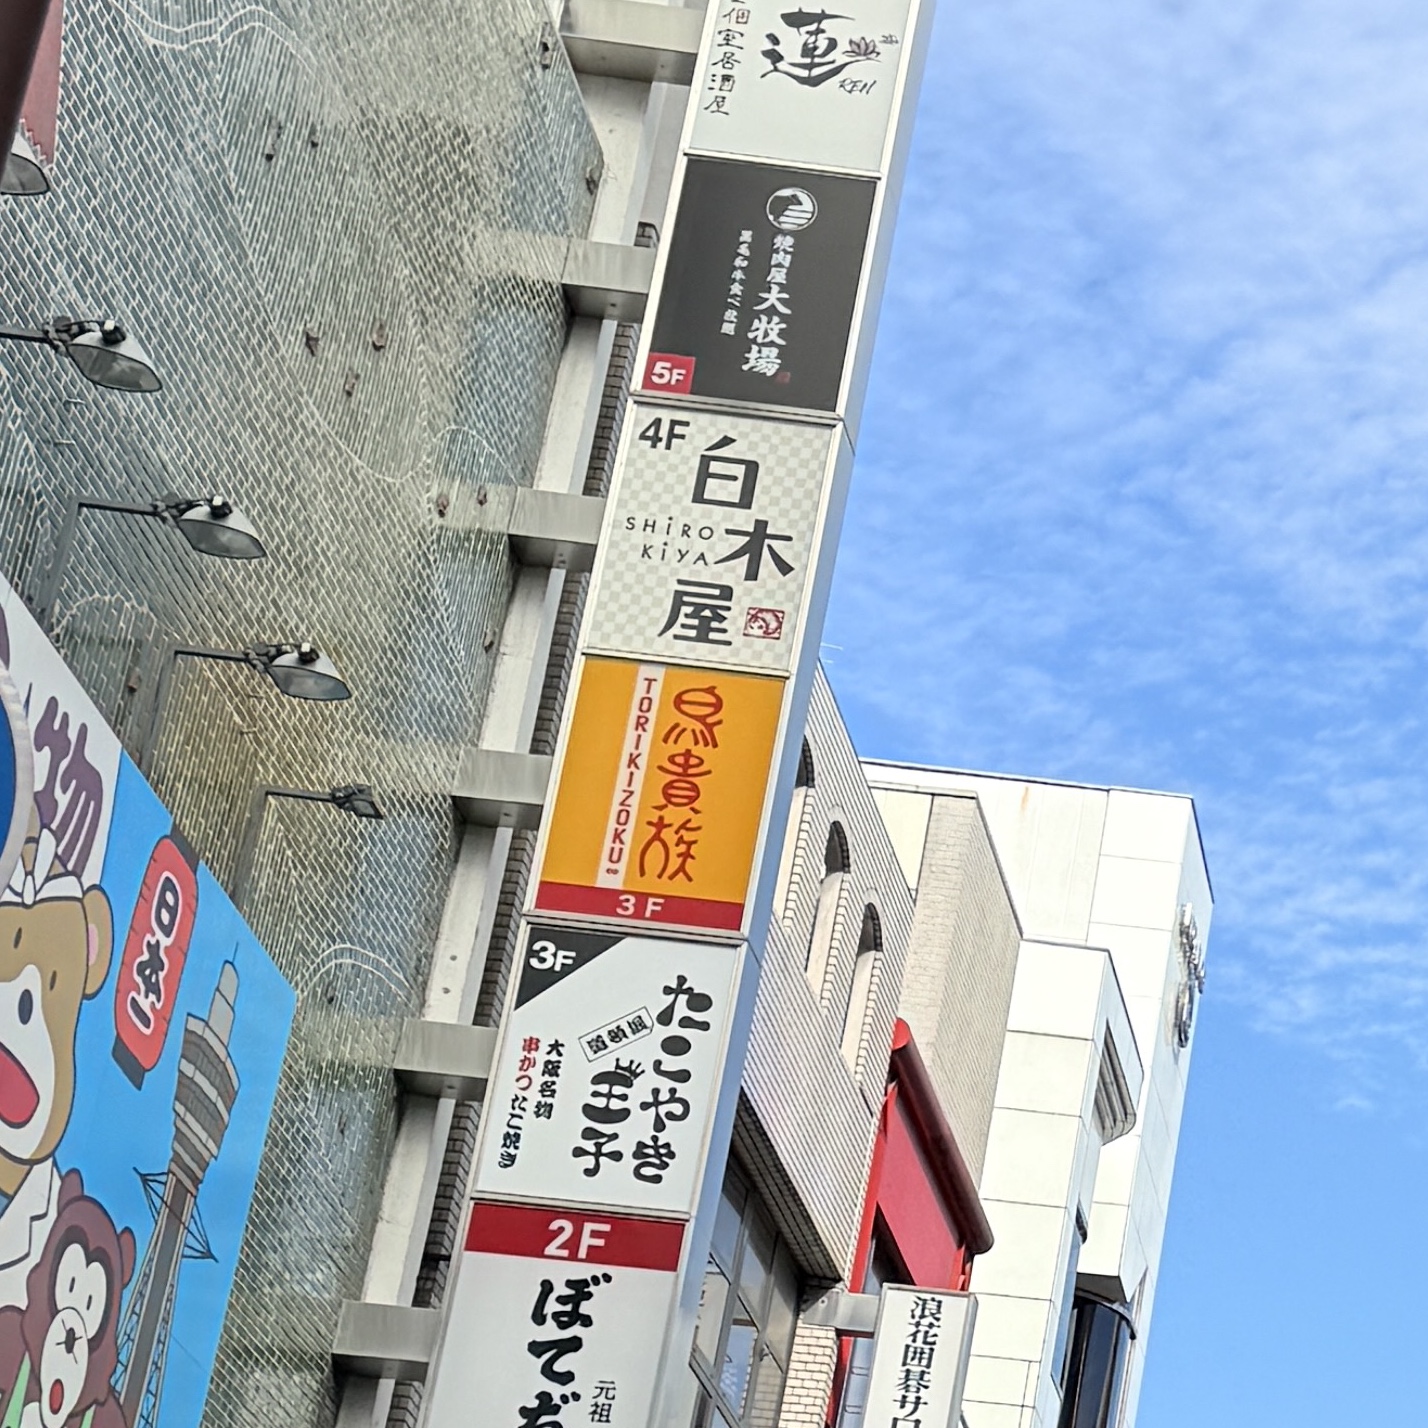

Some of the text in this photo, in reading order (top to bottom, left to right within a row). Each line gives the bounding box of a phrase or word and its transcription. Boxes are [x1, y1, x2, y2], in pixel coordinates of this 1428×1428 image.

[704, 0, 750, 116] 個室居酒屋
[651, 361, 686, 386] 5F
[638, 417, 690, 451] 4F
[658, 435, 795, 647] 白木屋
[607, 677, 658, 865] TORIKIZOKU
[638, 685, 724, 883] 鳥貴族
[529, 940, 576, 972] 3F
[632, 975, 713, 1184] たこやき
[543, 1219, 611, 1259] 2F
